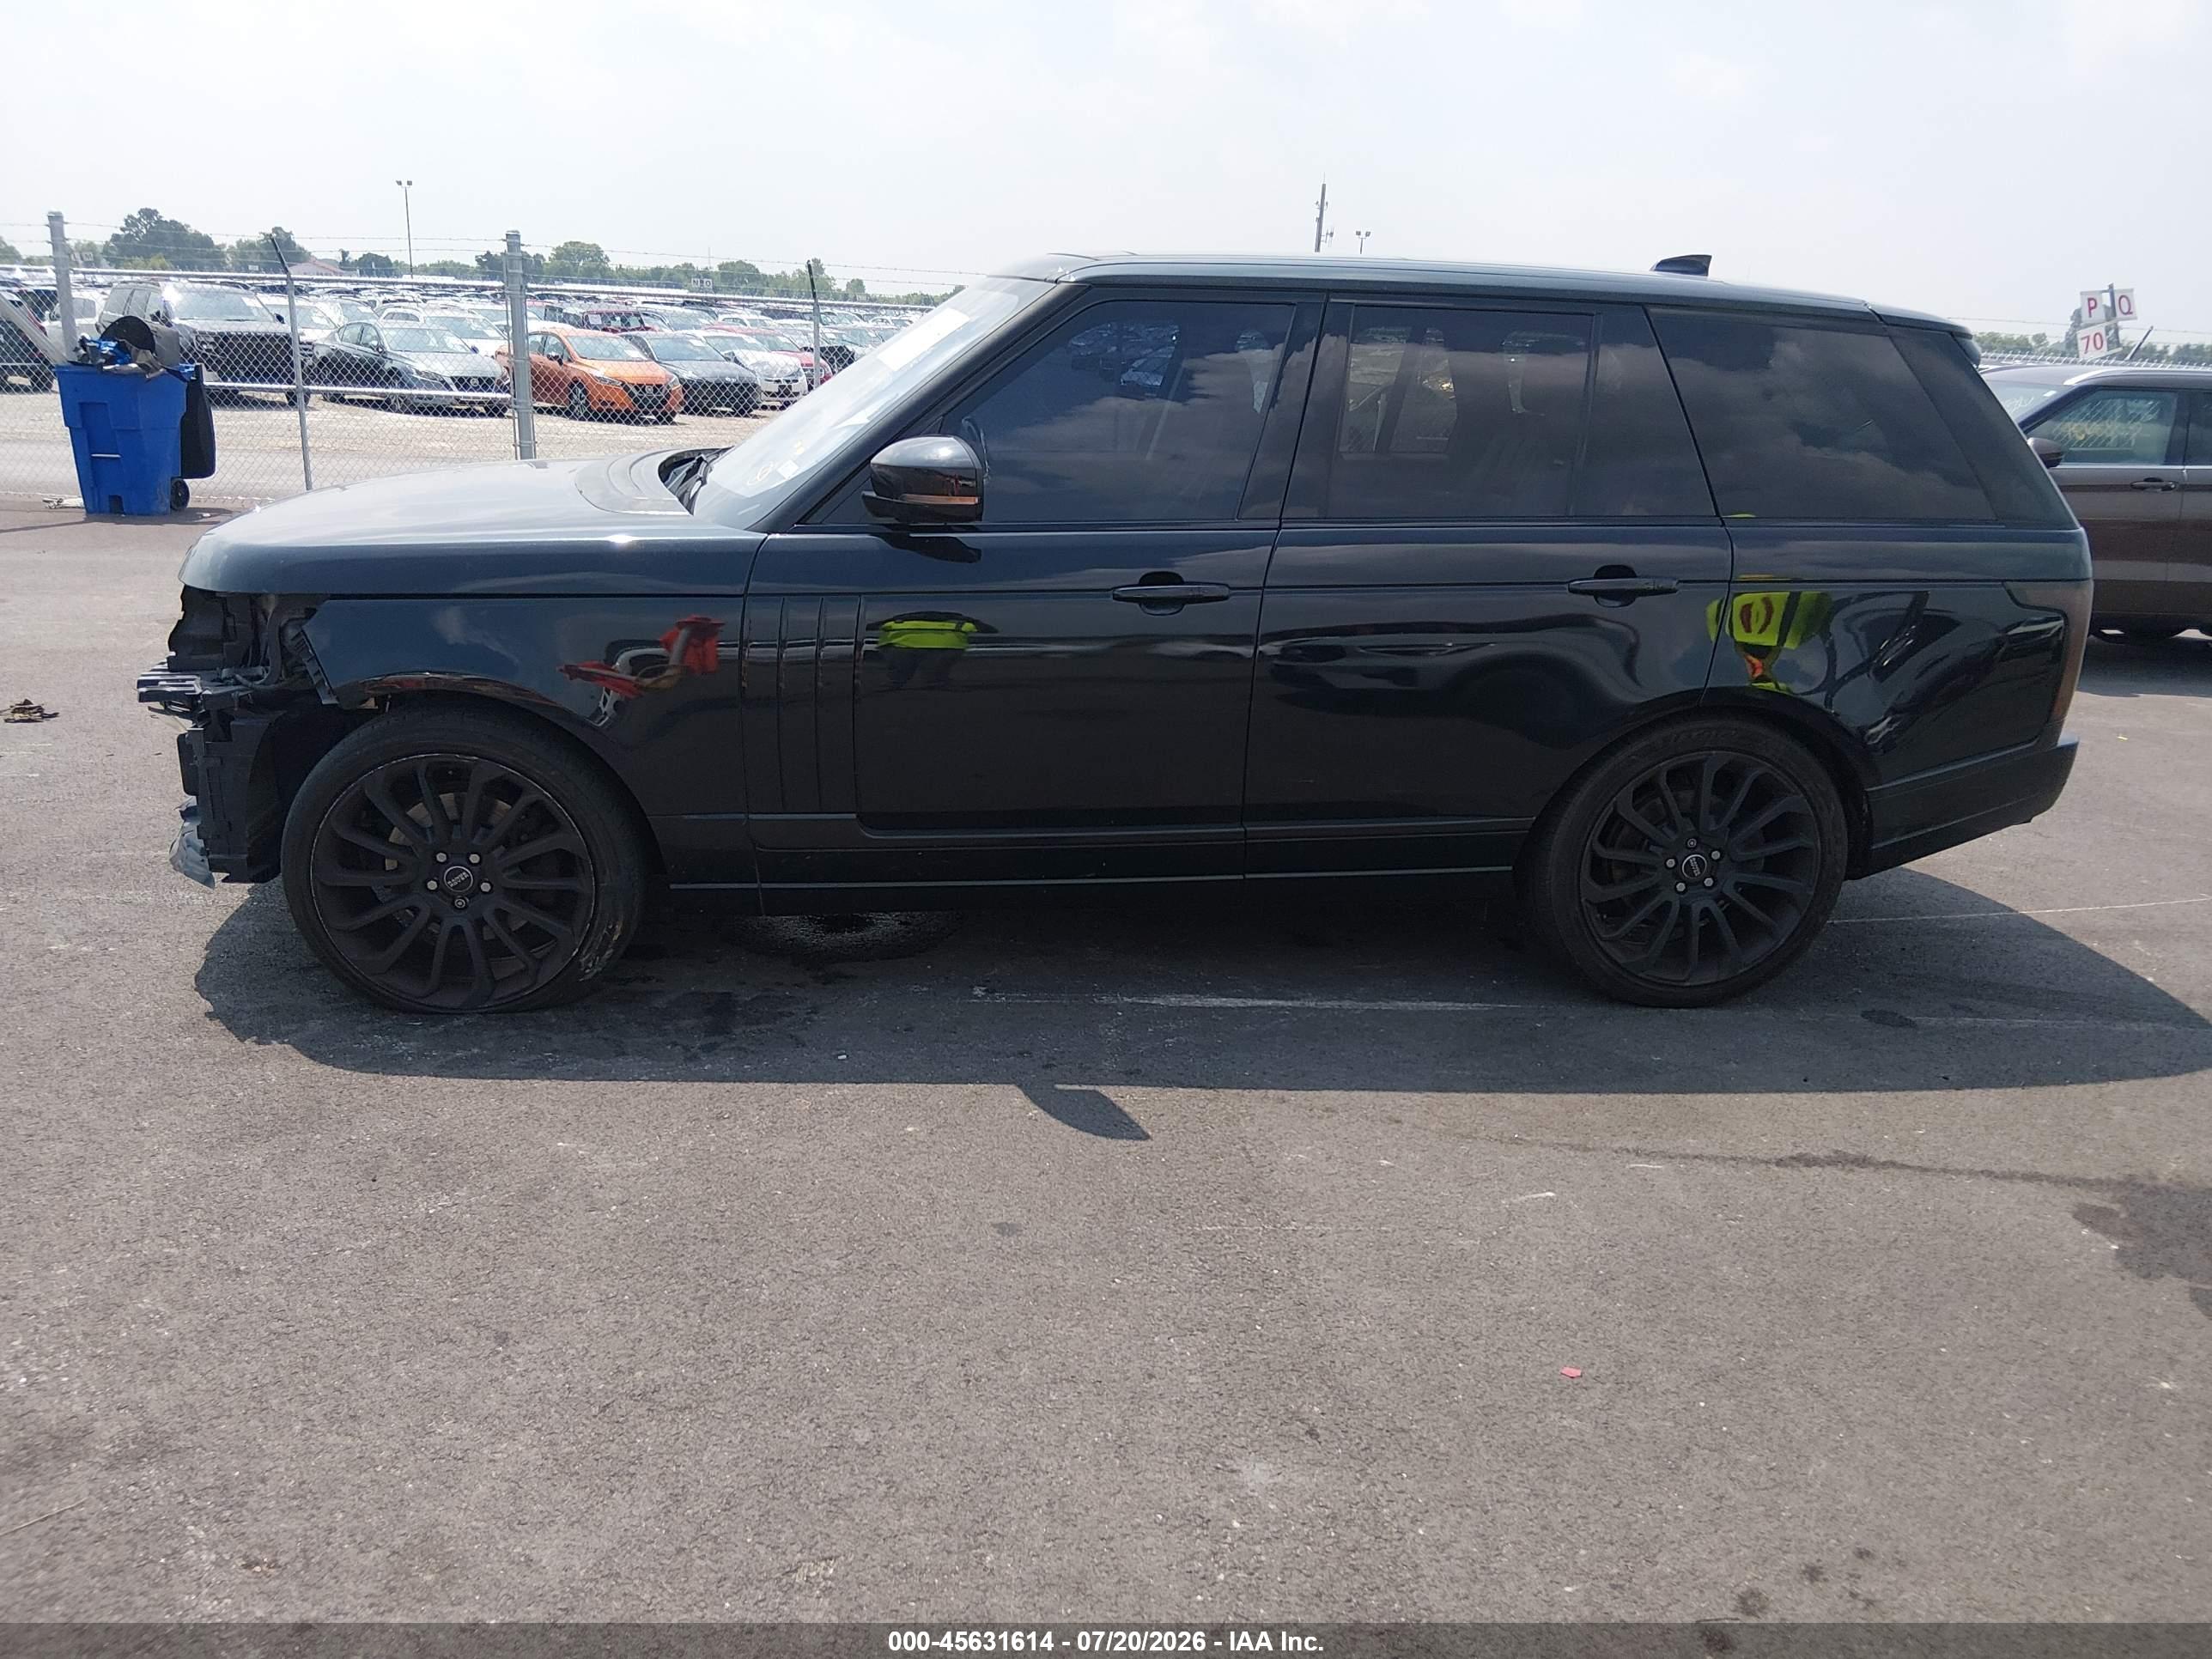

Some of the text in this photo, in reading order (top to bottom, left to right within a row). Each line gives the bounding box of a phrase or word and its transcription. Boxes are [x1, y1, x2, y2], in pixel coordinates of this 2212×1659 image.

[2087, 297, 2097, 318] P
[2118, 295, 2133, 315] Q
[2081, 332, 2103, 354] 70
